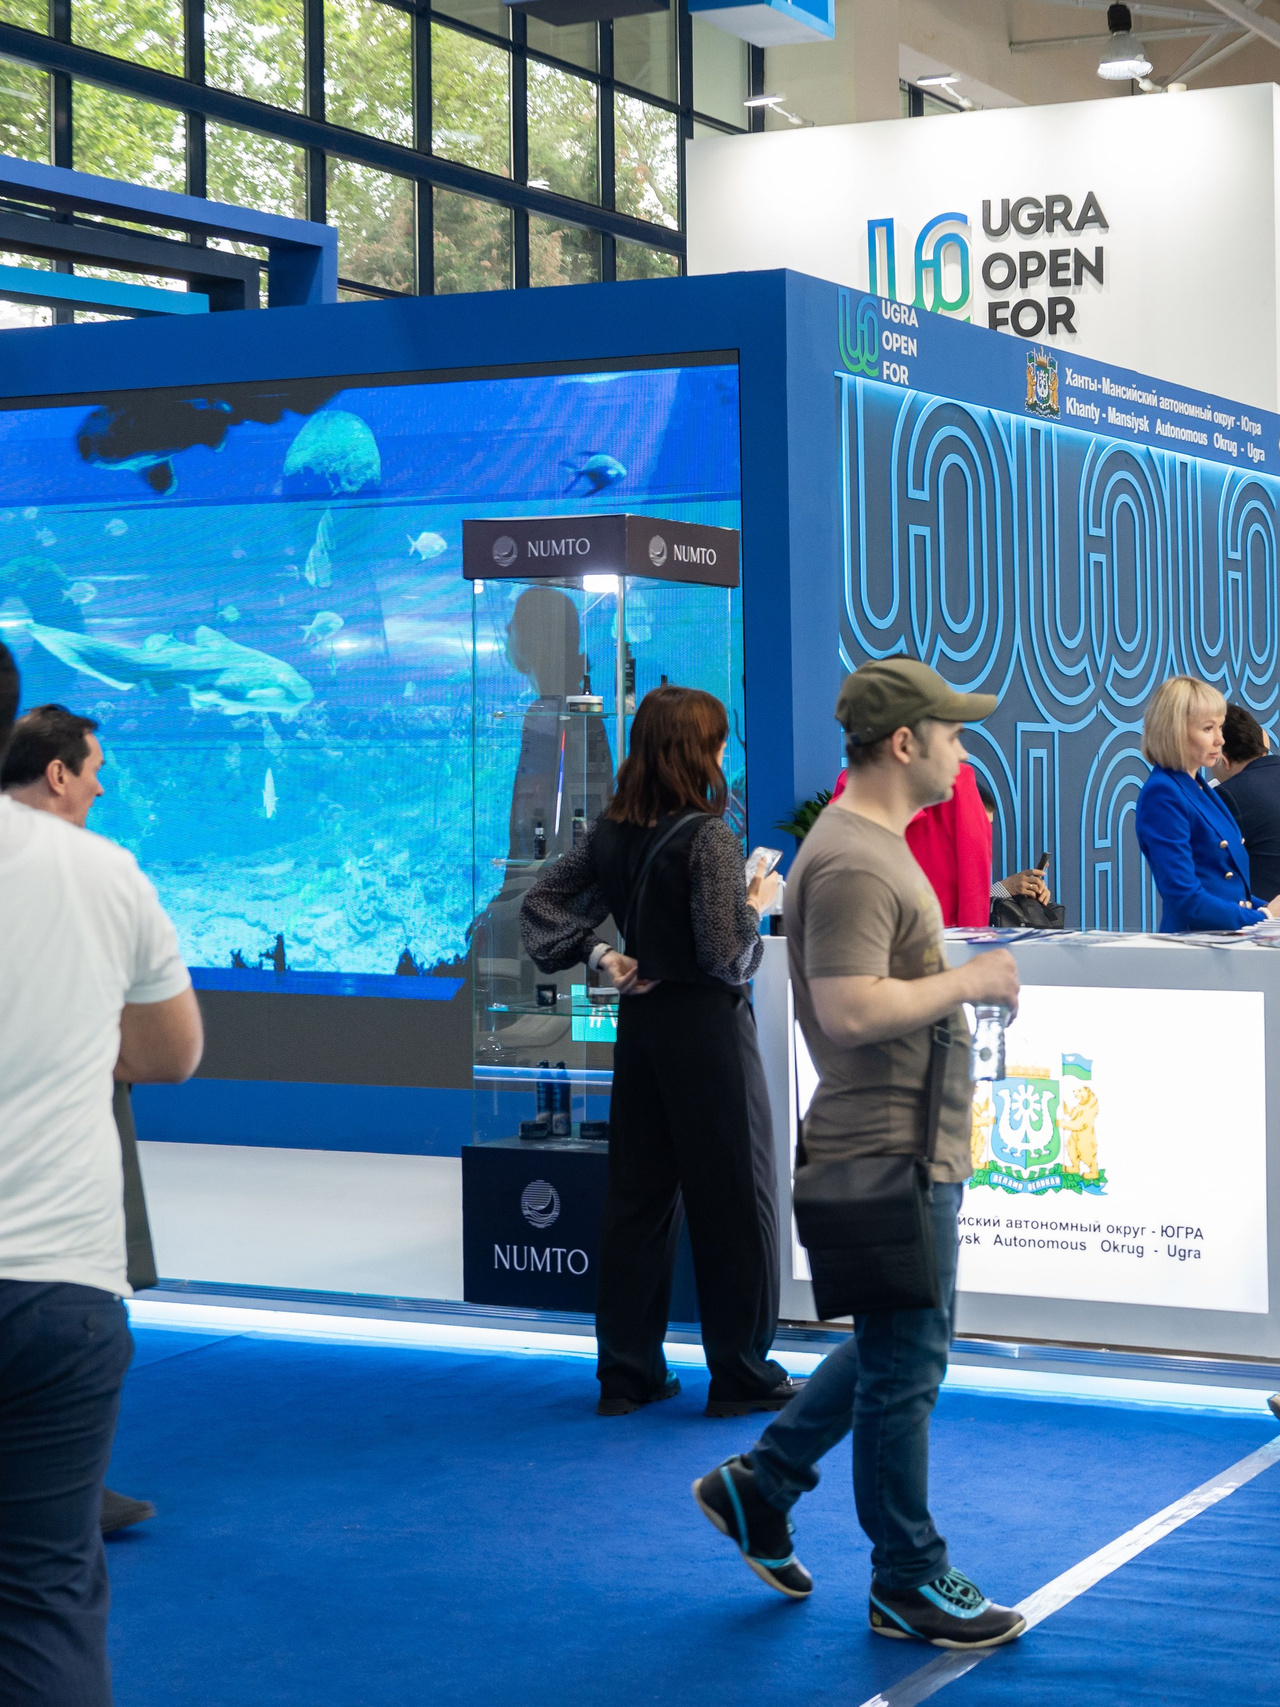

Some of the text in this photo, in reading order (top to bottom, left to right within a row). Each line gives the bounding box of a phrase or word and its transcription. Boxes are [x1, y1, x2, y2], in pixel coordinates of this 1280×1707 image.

[982, 191, 1109, 236] UGRA
[982, 246, 1104, 290] OPEN
[882, 299, 919, 328] UGRA
[988, 296, 1077, 337] FOR
[881, 330, 917, 358] OPEN
[882, 361, 909, 385] FOR
[1066, 396, 1100, 424] Khanty
[1107, 406, 1149, 433] Mansiysk
[1155, 418, 1208, 446] Autonomous
[1213, 433, 1237, 457] Okrug
[1247, 442, 1265, 463] Ugra
[1159, 395, 1212, 422] автономный
[1213, 413, 1236, 431] округ
[1241, 415, 1262, 436] Югра
[527, 537, 591, 558] NUMTO
[673, 544, 717, 566] NUMTO
[957, 1213, 1001, 1227] йский
[1006, 1218, 1101, 1233] автономный
[1106, 1224, 1147, 1238] округ
[1161, 1225, 1204, 1240] ЮГРА
[493, 1243, 589, 1275] NUMTO
[958, 1232, 981, 1246] ysk
[993, 1234, 1087, 1251] Autonomous
[1100, 1240, 1144, 1258] Okrug
[1167, 1244, 1201, 1261] Ugra
